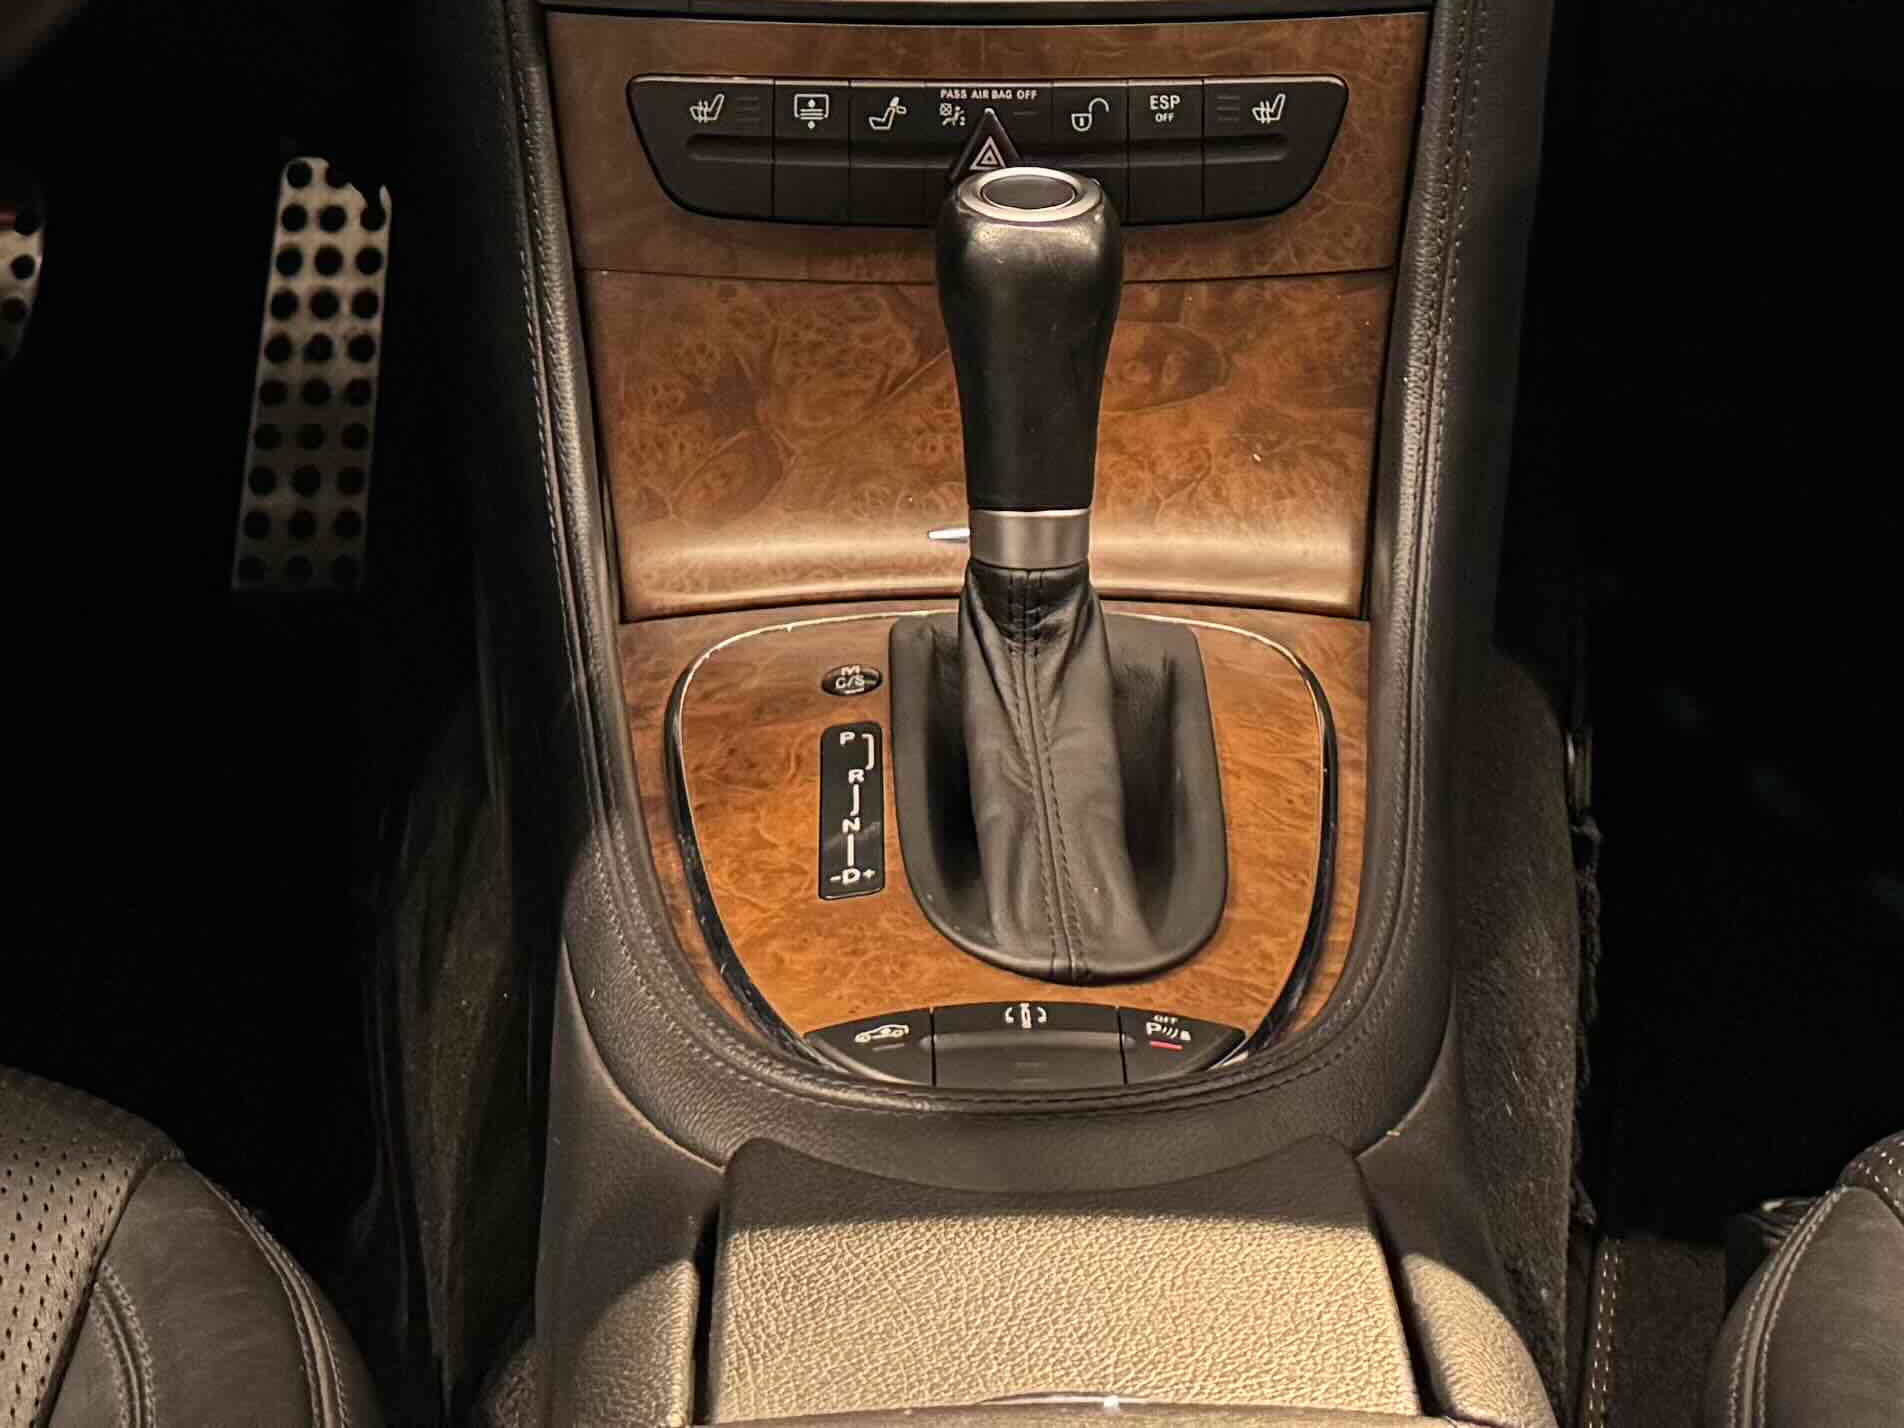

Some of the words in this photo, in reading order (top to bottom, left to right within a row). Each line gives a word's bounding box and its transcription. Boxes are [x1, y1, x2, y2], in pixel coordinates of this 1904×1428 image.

[940, 88, 968, 100] PASS
[1016, 88, 1038, 101] OFF
[1149, 94, 1182, 111] ESP
[1155, 111, 1175, 123] OFF
[835, 675, 866, 691] C/S
[839, 731, 856, 746] P
[848, 768, 865, 785] R
[842, 817, 862, 834] N
